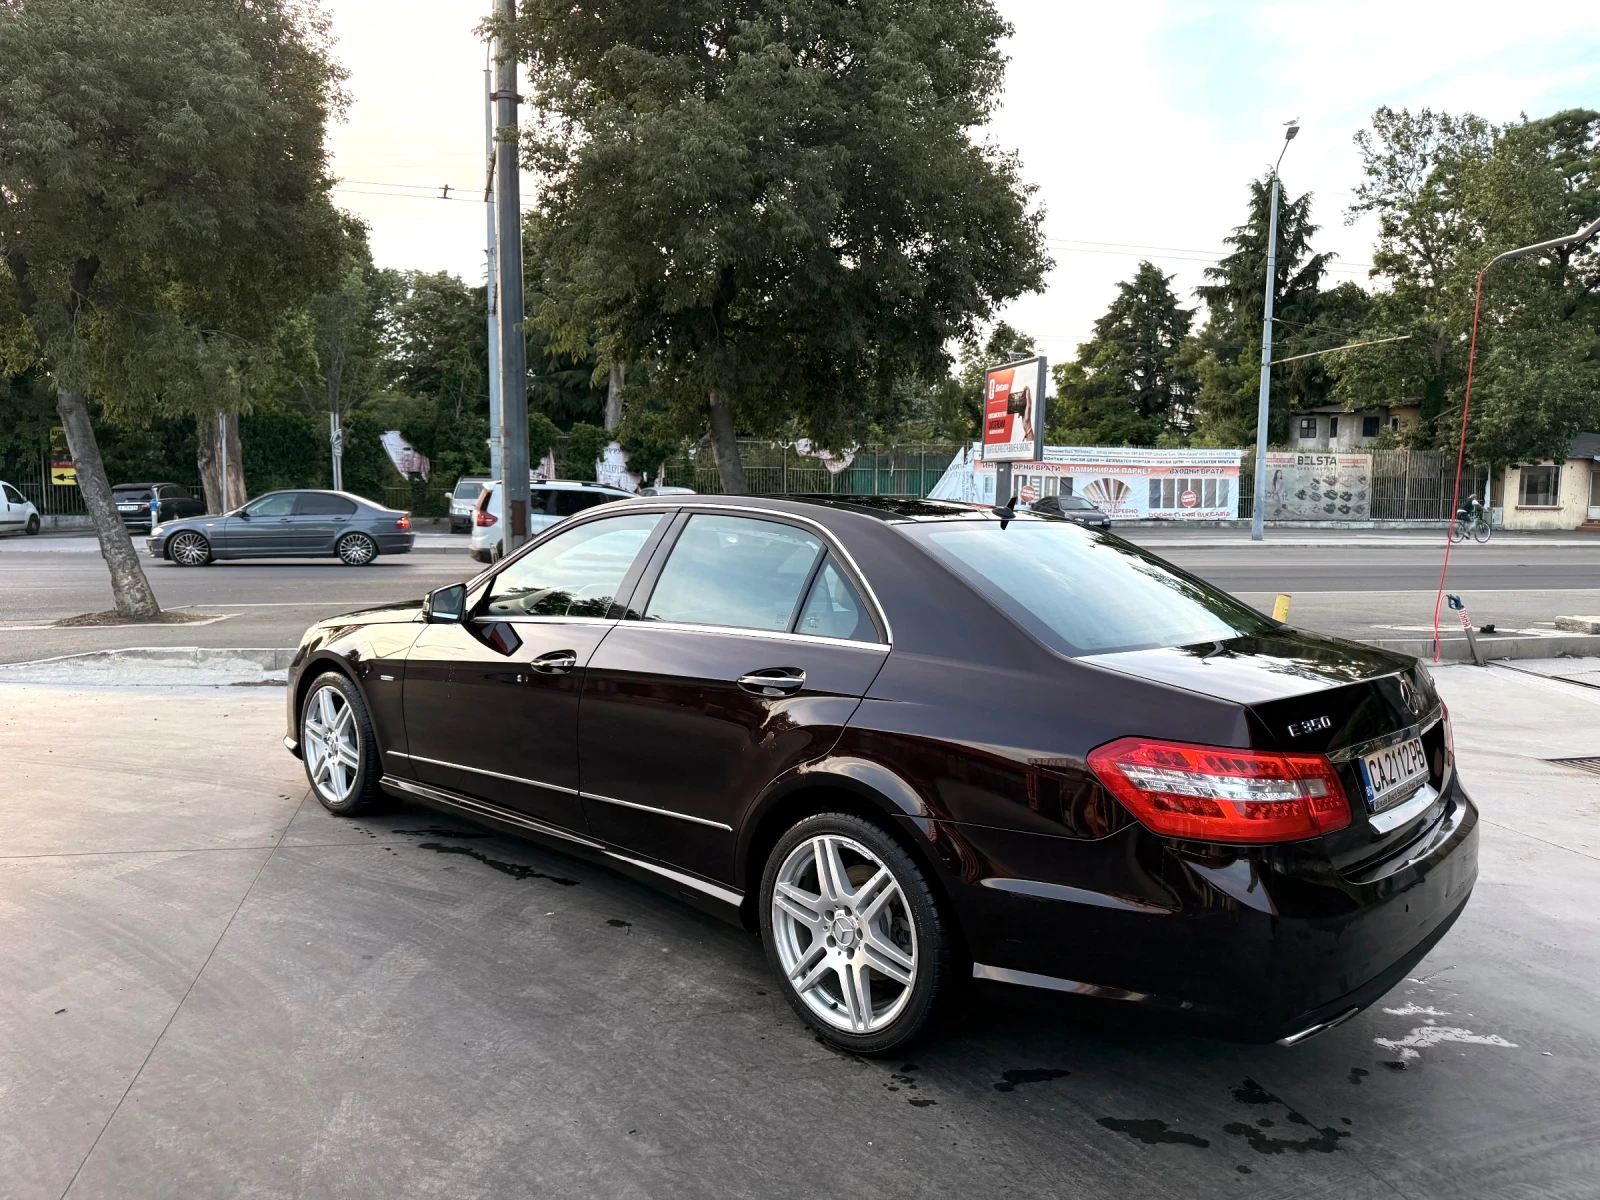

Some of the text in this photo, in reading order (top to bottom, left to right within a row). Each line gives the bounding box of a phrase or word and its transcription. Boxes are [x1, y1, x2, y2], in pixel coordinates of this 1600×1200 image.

[1297, 455, 1337, 466] BELSTA
[1035, 464, 1061, 472] ВРАТИ
[1069, 466, 1152, 475] ЛАМИНИРАН ПАРКЕТ
[1288, 715, 1332, 737] E 350
